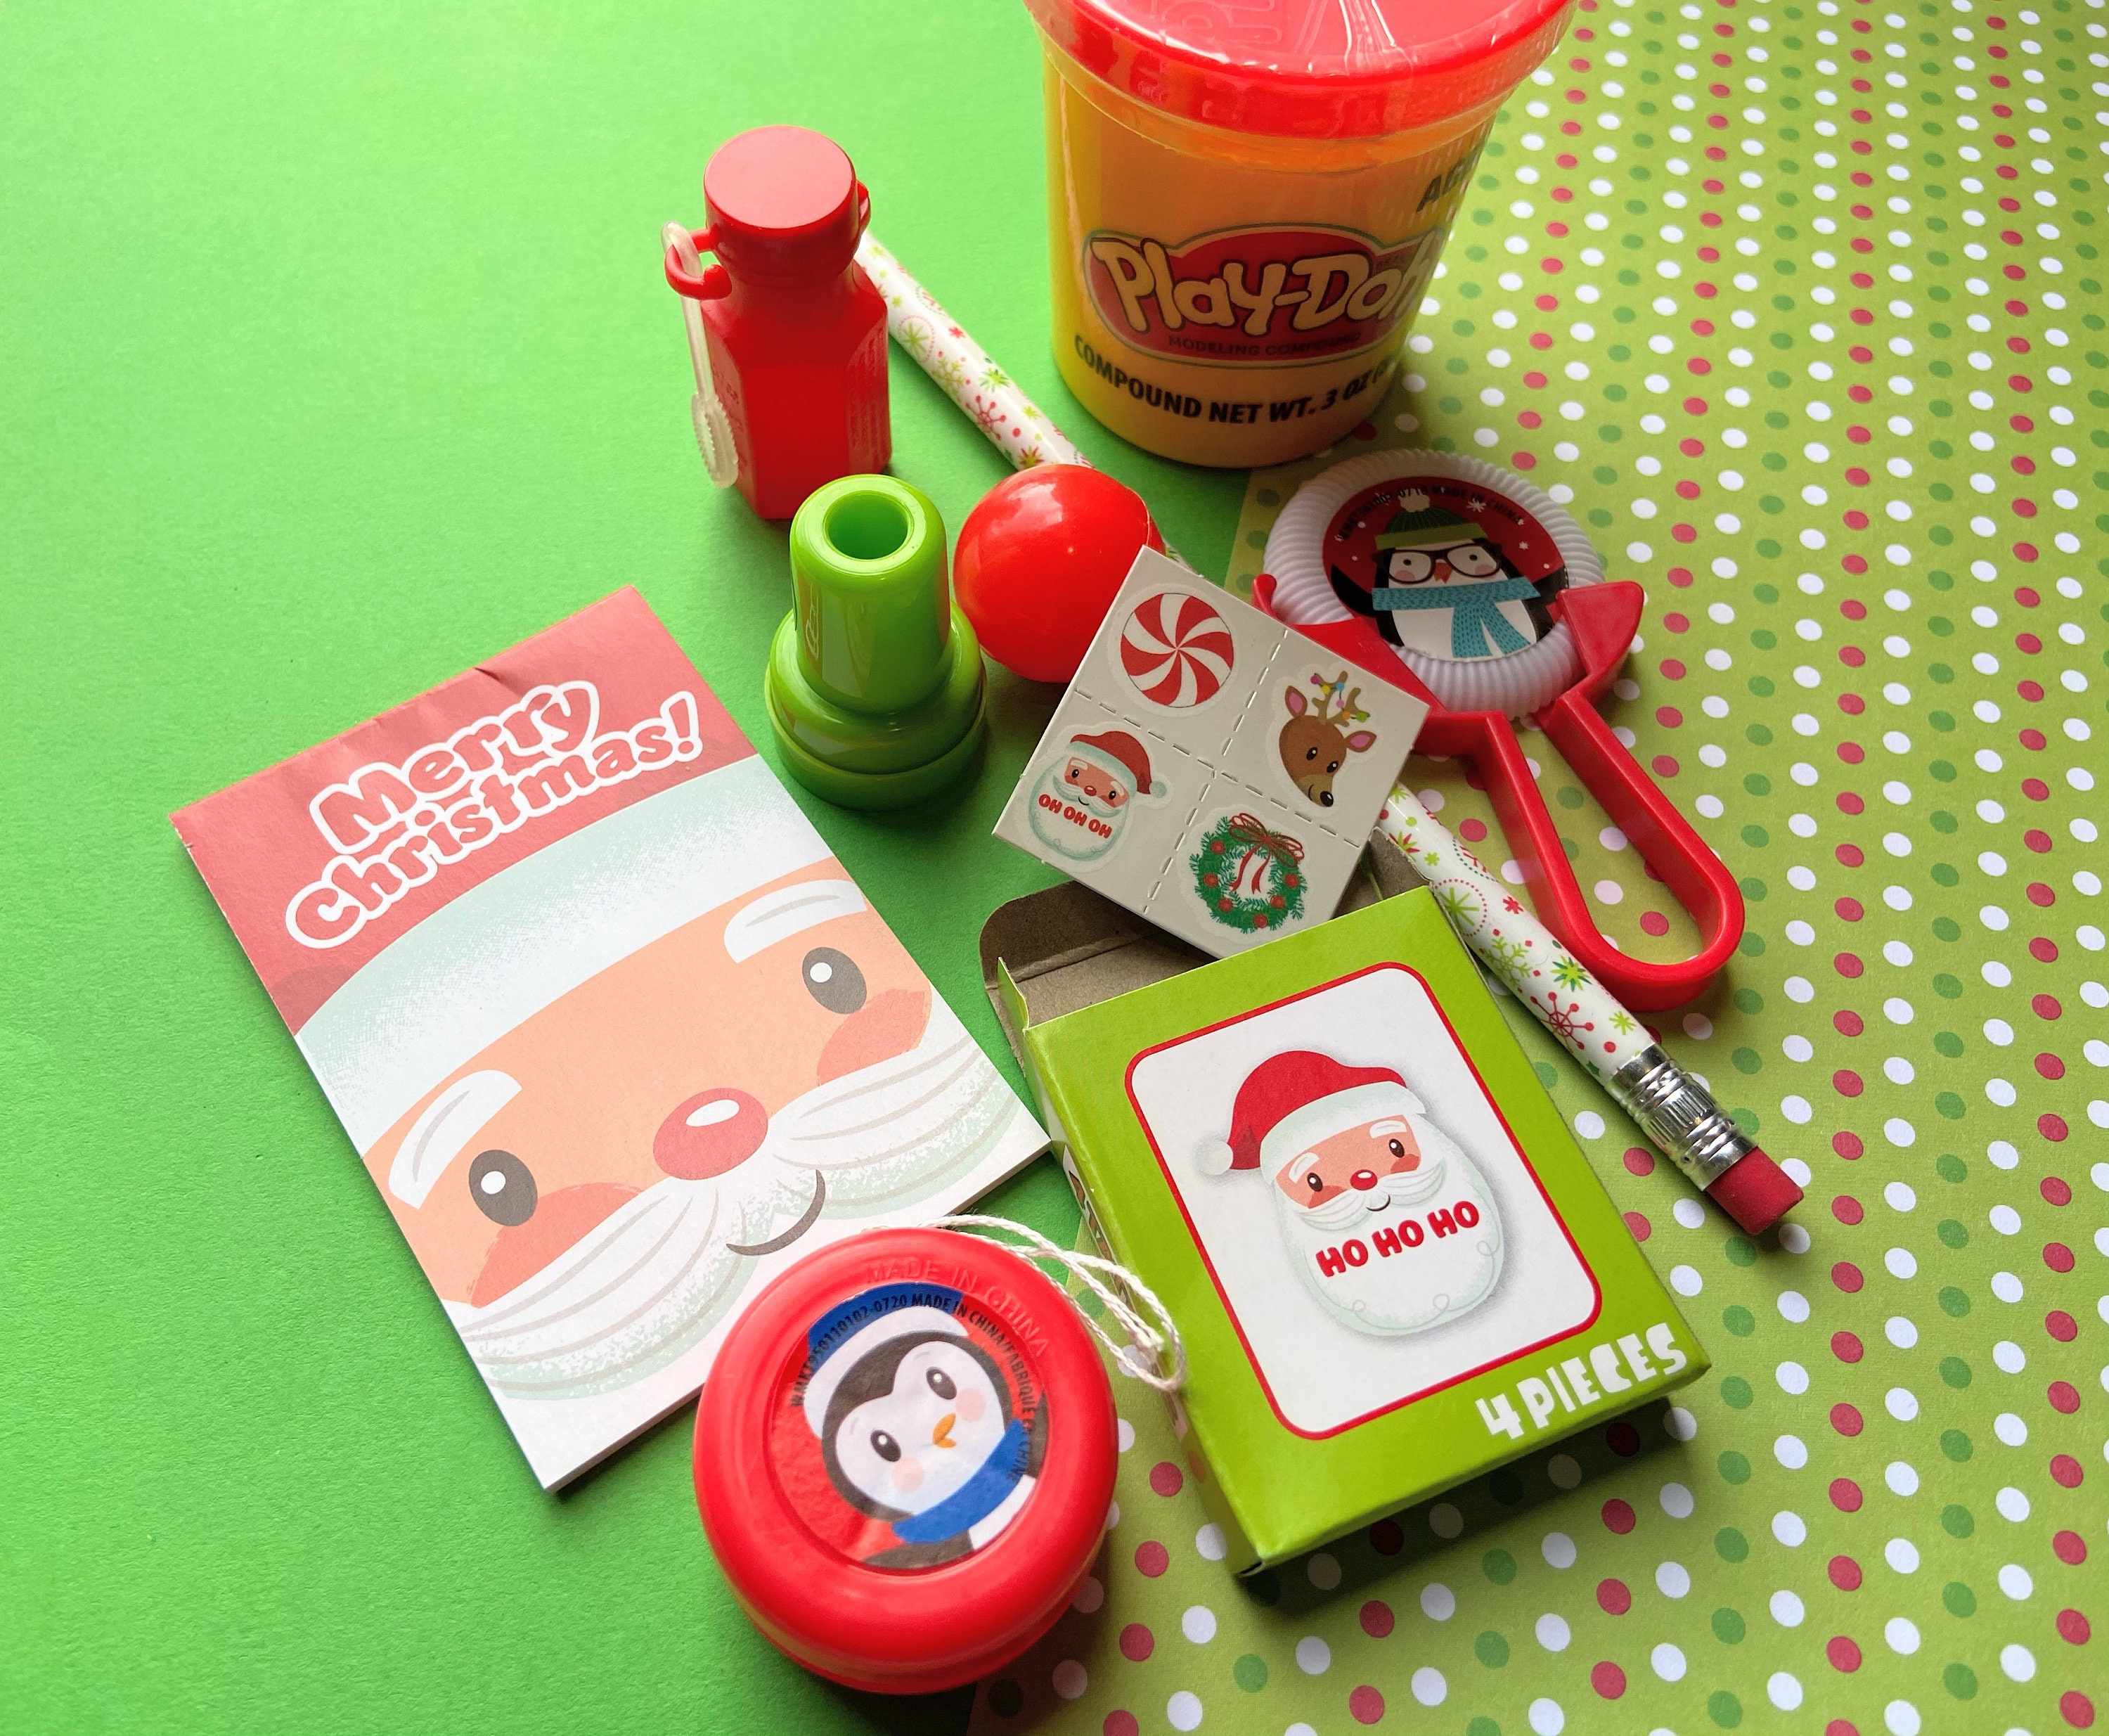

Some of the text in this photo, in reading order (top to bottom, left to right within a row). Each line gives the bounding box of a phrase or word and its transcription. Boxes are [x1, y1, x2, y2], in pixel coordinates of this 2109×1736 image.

[1089, 229, 1438, 337] Play-Doh
[1075, 334, 1201, 418] COMPOUND
[1208, 401, 1263, 424] NET
[1270, 396, 1315, 423] WT.
[1320, 388, 1339, 411] 3
[1168, 335, 1260, 356] MODELING
[310, 681, 600, 855] Merry
[1315, 1200, 1479, 1278] HO HO HO
[866, 1259, 1049, 1356] MADE IN CHINA
[912, 1293, 952, 1311] MADE
[953, 1301, 968, 1318] IN
[1475, 1323, 1687, 1440] 4 PIECES
